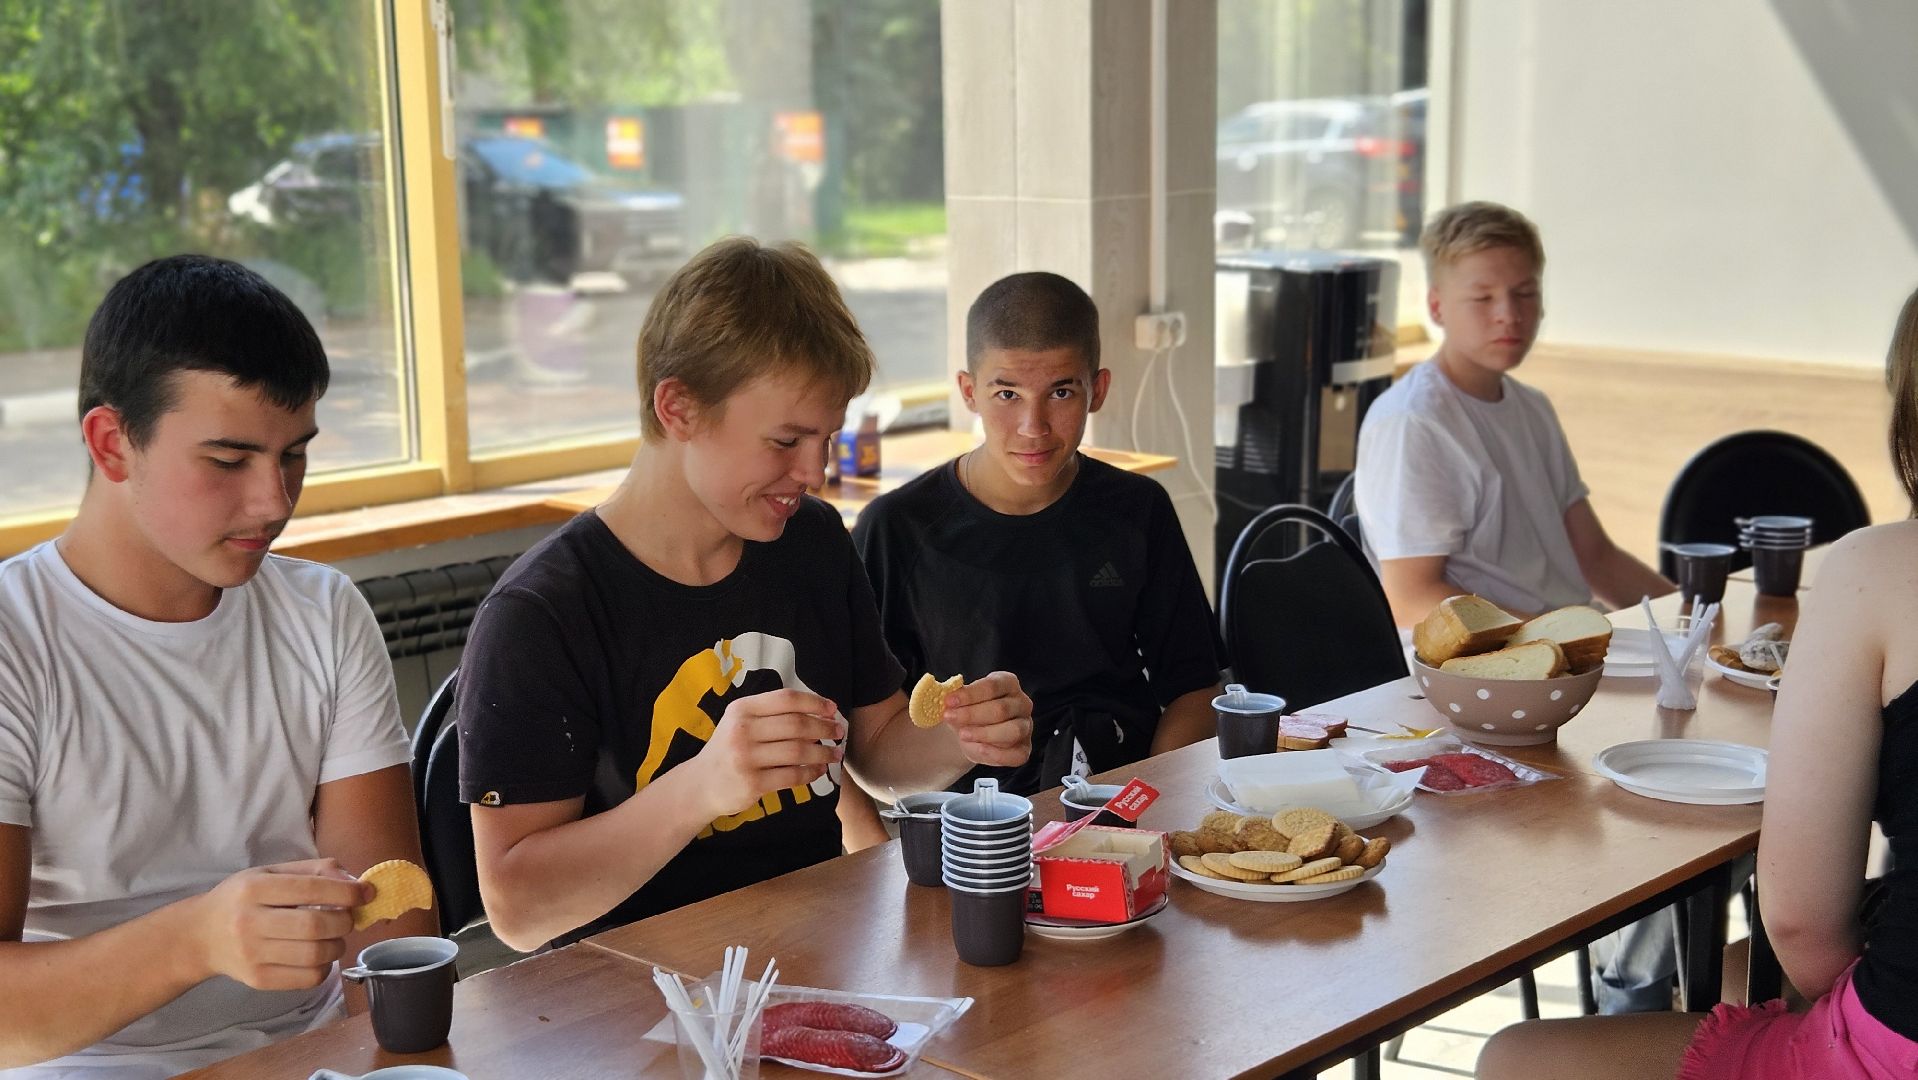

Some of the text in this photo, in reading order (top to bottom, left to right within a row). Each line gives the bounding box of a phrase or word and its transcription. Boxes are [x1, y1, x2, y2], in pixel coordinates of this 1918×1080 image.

[1115, 786, 1142, 809] Русский
[1129, 794, 1148, 810] сахар
[1066, 884, 1100, 893] Русский
[1072, 891, 1095, 899] сахар
